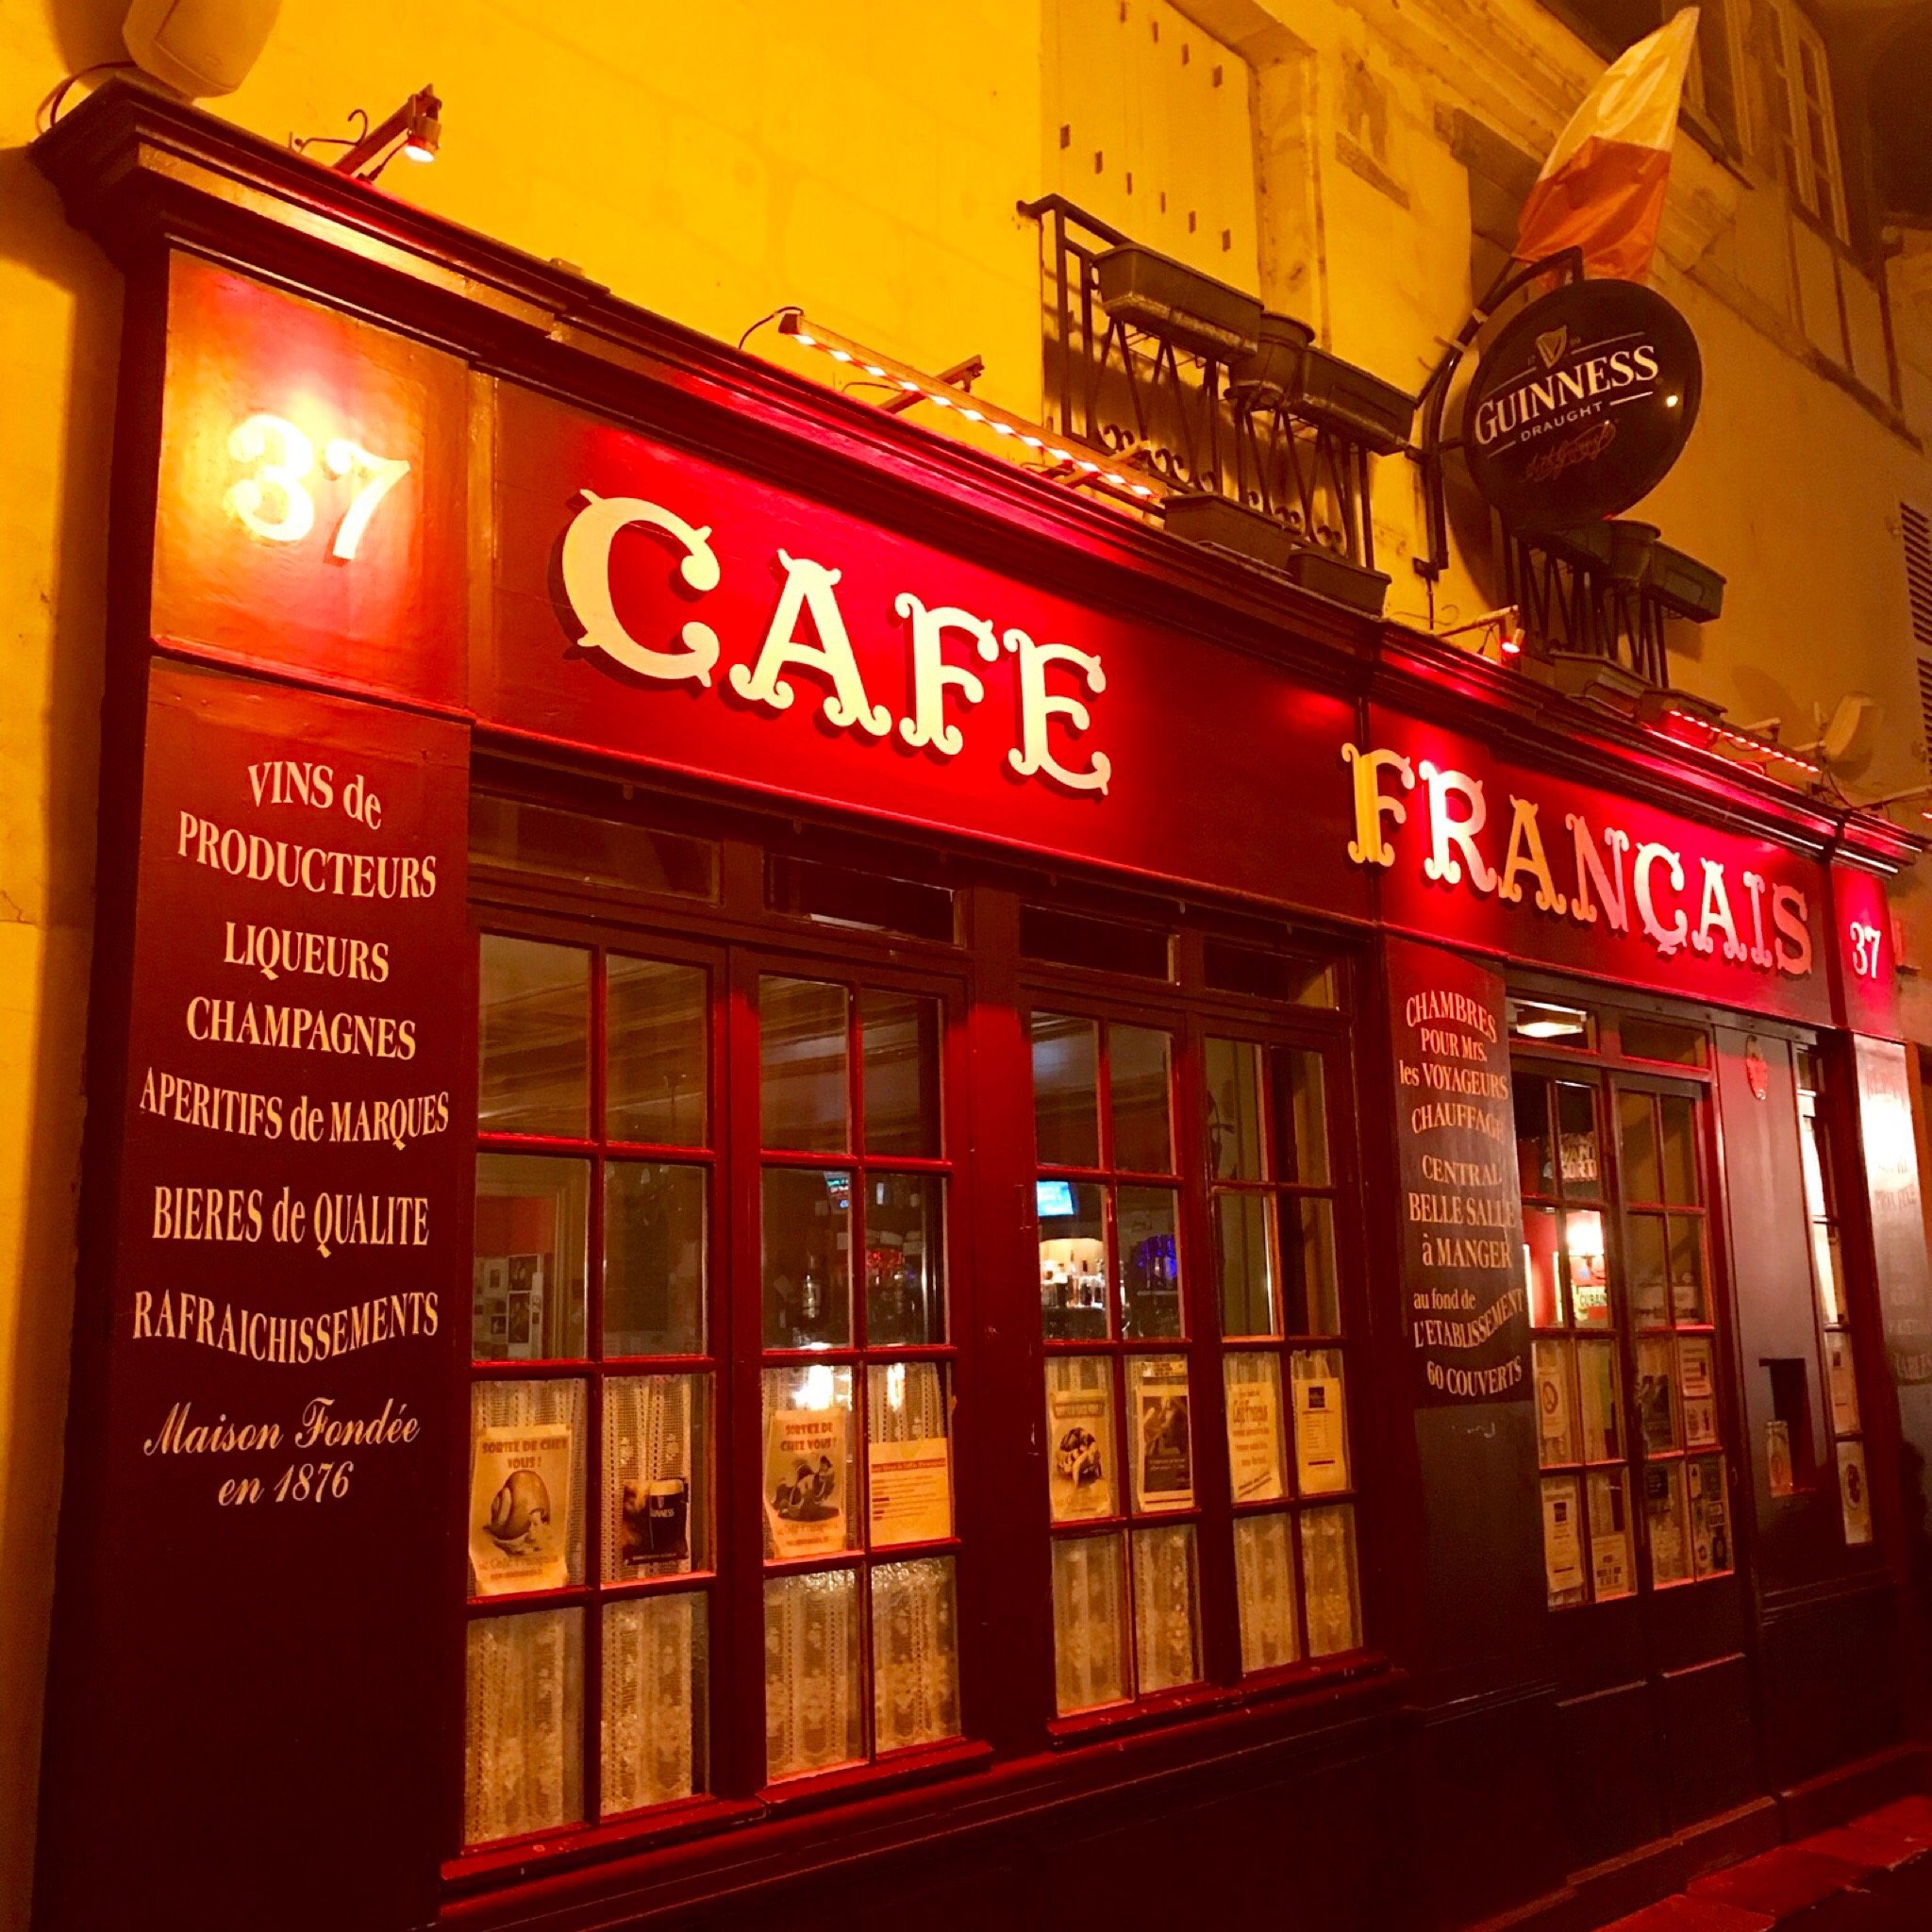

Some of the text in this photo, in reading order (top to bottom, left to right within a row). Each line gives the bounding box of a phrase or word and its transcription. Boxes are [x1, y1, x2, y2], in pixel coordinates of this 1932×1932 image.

[1474, 345, 1659, 445] GUINNESS
[1520, 401, 1603, 442] DRAUGHT
[222, 413, 411, 559] 37
[562, 489, 1812, 974] CAFE FRANÇAIS
[248, 761, 382, 830] VINS de
[177, 810, 437, 899] PRODUCTEURS
[224, 921, 389, 983] LIQUEURS
[1849, 921, 1881, 979] 37
[186, 996, 416, 1060] CHAMPAGNES
[1407, 990, 1496, 1043] CHAMBRES
[1421, 1027, 1459, 1058] POUR
[1399, 1059, 1509, 1100] les VOYAGEURS
[140, 1067, 449, 1151] APERITIFS de MARQUES
[1411, 1102, 1505, 1143] CHAUFFAGE
[1422, 1154, 1503, 1186] CENTRAL
[152, 1186, 429, 1258] BIERES de QUALITE
[1408, 1191, 1516, 1228] BELLE SALLE
[1422, 1233, 1513, 1269] à MANGER
[132, 1289, 439, 1363] RAFRAICHISSEMENTS
[1413, 1288, 1476, 1309] au fond de
[1413, 1288, 1524, 1348] L'ETABLISSEMENT
[1426, 1355, 1522, 1397] 60 COUVERTS
[143, 1397, 420, 1456] Maison Fondée
[218, 1461, 354, 1506] en 1876
